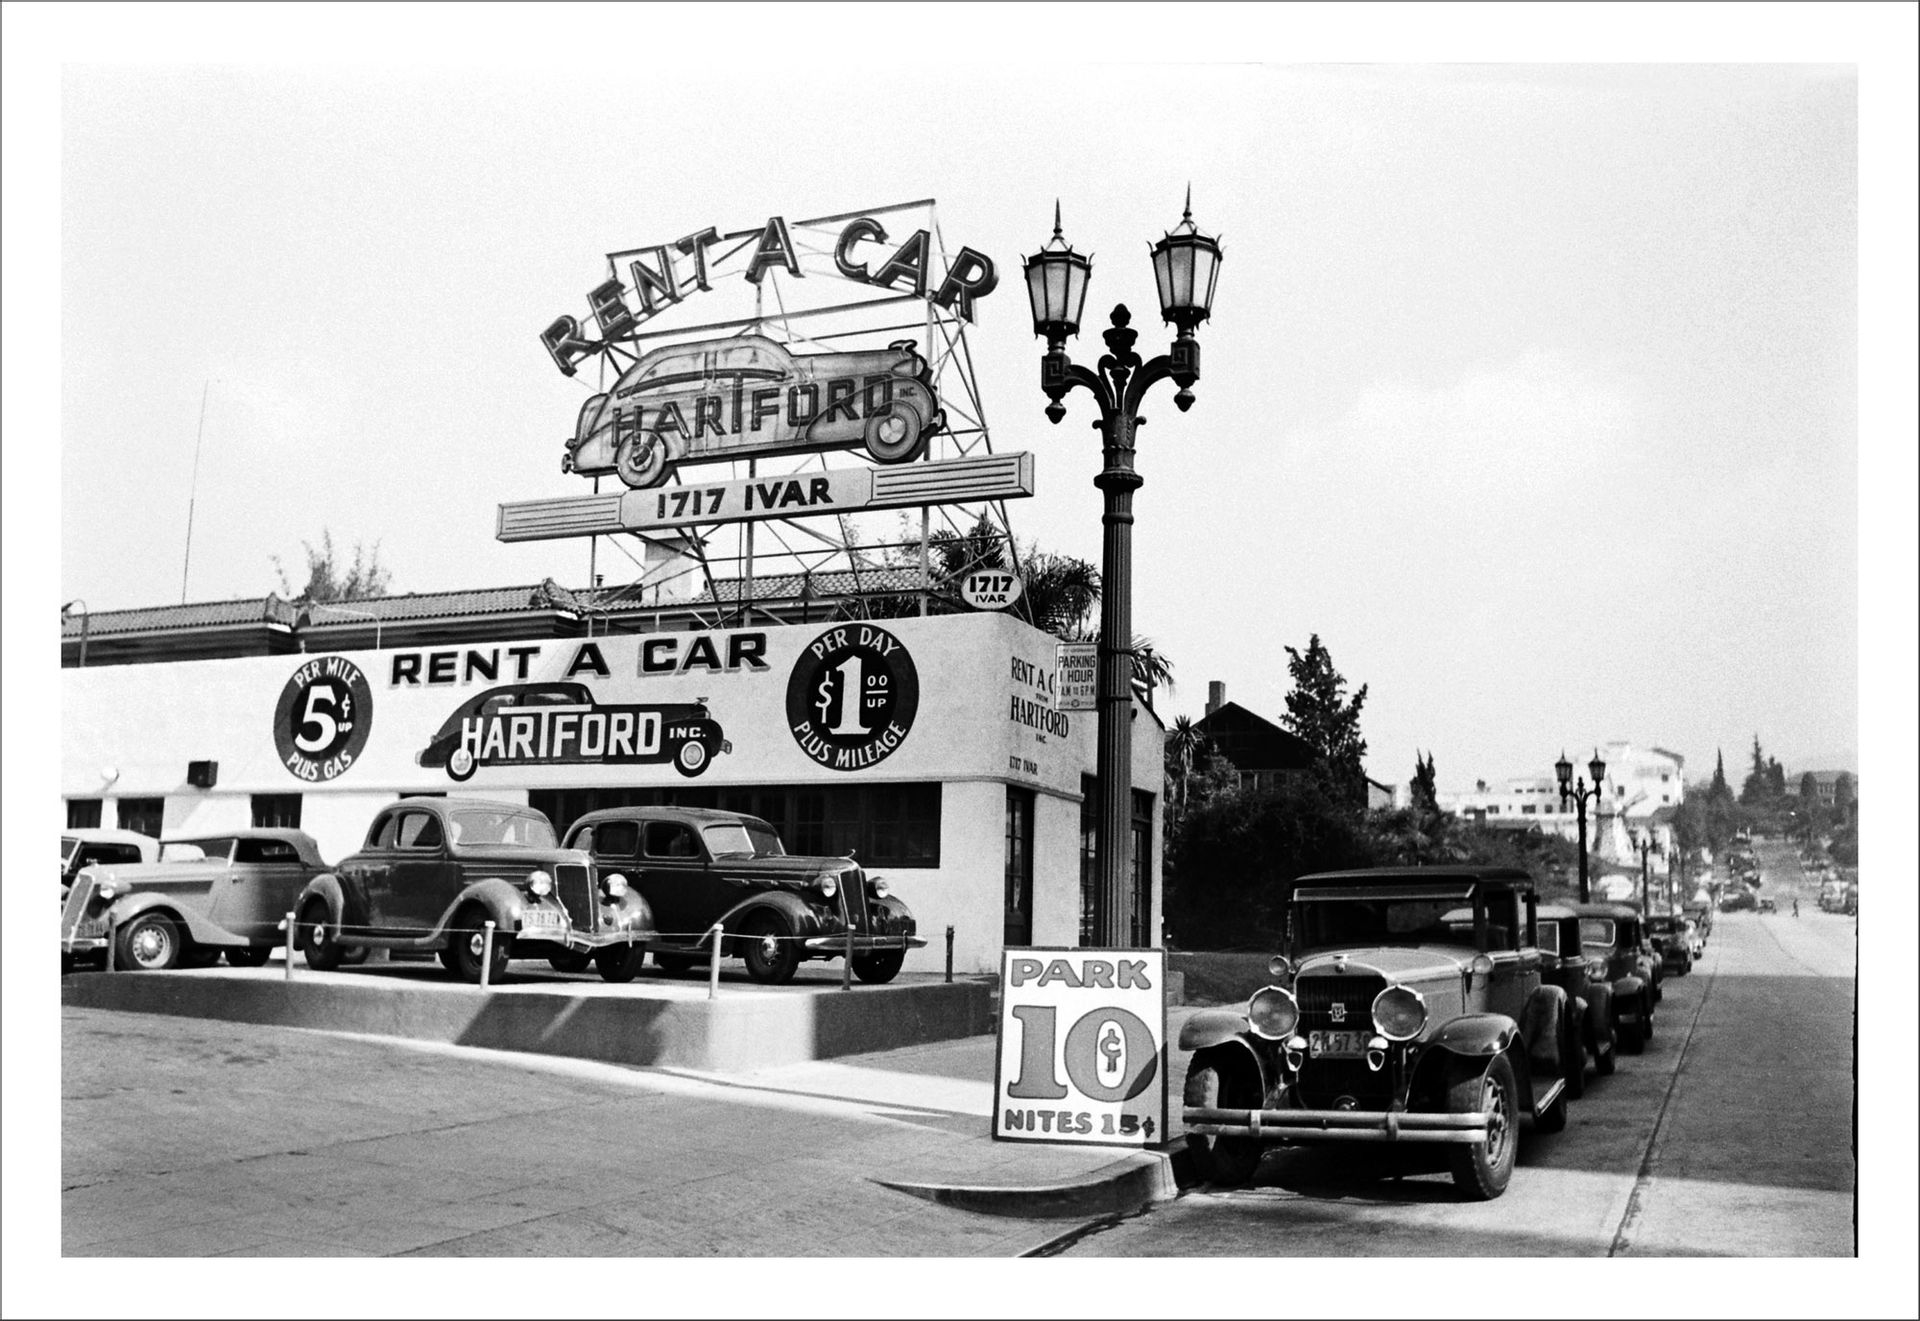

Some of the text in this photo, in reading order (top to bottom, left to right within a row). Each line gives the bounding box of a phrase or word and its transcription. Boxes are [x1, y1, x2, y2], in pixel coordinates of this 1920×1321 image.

[540, 216, 1000, 376] RENT A CAR
[611, 368, 893, 466] HARTFORD
[657, 477, 833, 519] 1717 IVAR
[969, 576, 1013, 593] 1717
[975, 594, 1006, 603] IVAR
[811, 626, 900, 660] PER DAY
[294, 658, 360, 688] PER MILE
[389, 633, 770, 688] RENT A CAR
[1011, 656, 1035, 686] RENT
[1037, 669, 1046, 691] A
[1058, 655, 1096, 668] PARKING
[1067, 670, 1094, 682] HOUR
[867, 698, 887, 708] UP
[1010, 695, 1069, 738] HARTFORD
[338, 722, 352, 732] UP
[461, 704, 706, 759] HARTFORD INC.
[793, 720, 906, 768] PLUS MILEAGE
[287, 750, 352, 781] PLUS GAS
[1023, 759, 1038, 776] IVAR
[1011, 959, 1152, 990] PARK
[1005, 1109, 1092, 1134] NITES
